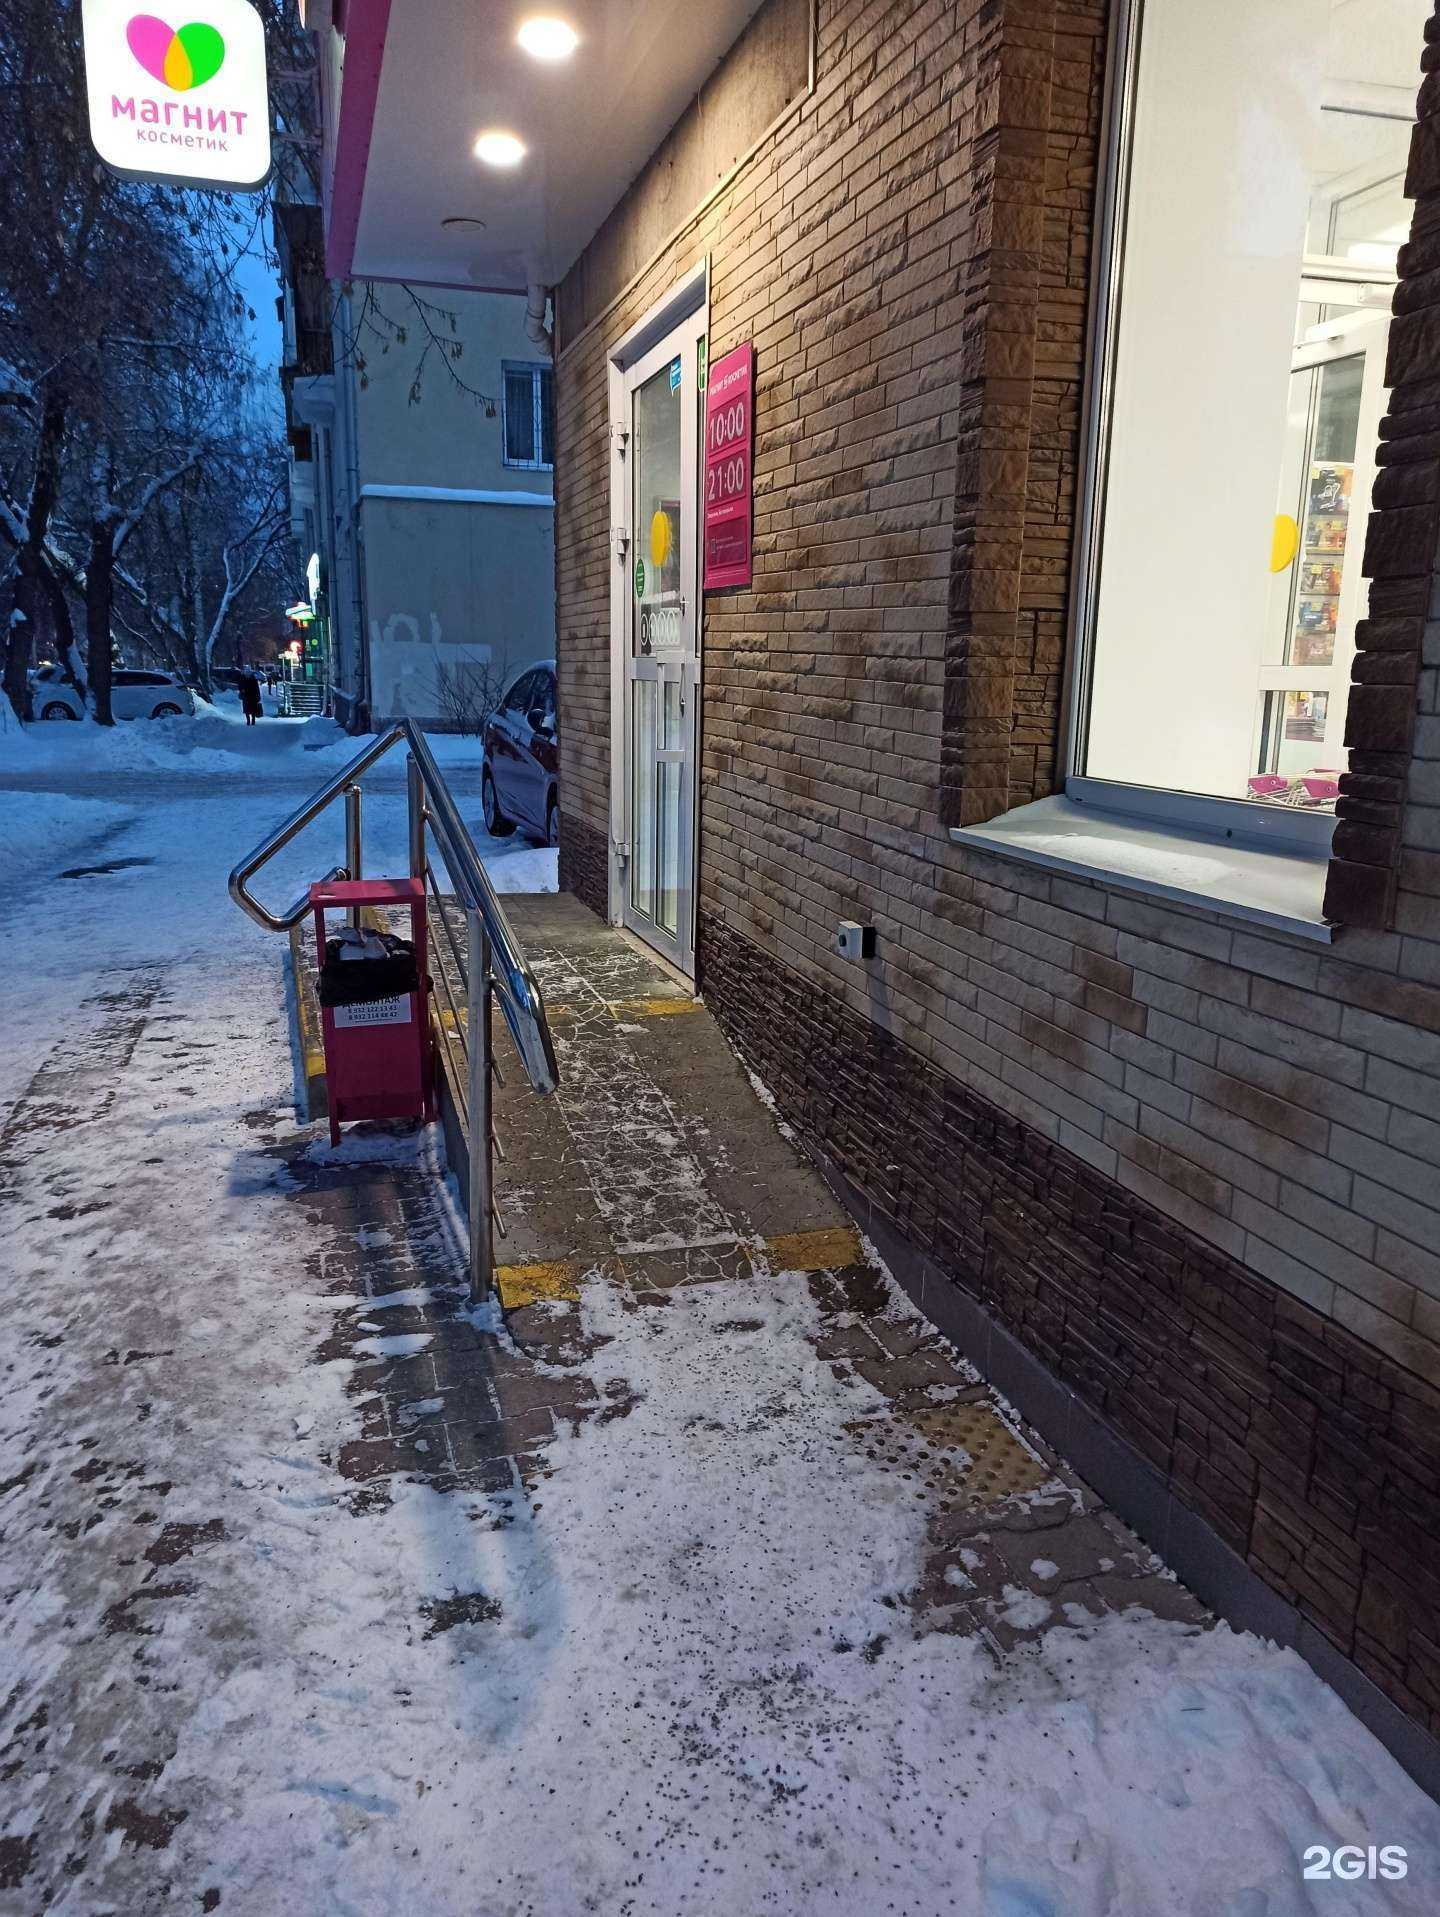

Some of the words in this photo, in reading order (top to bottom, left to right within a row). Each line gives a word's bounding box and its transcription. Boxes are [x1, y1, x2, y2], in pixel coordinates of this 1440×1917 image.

[137, 128, 228, 152] косметик
[709, 402, 745, 450] 10:00
[708, 457, 744, 500] 21:00
